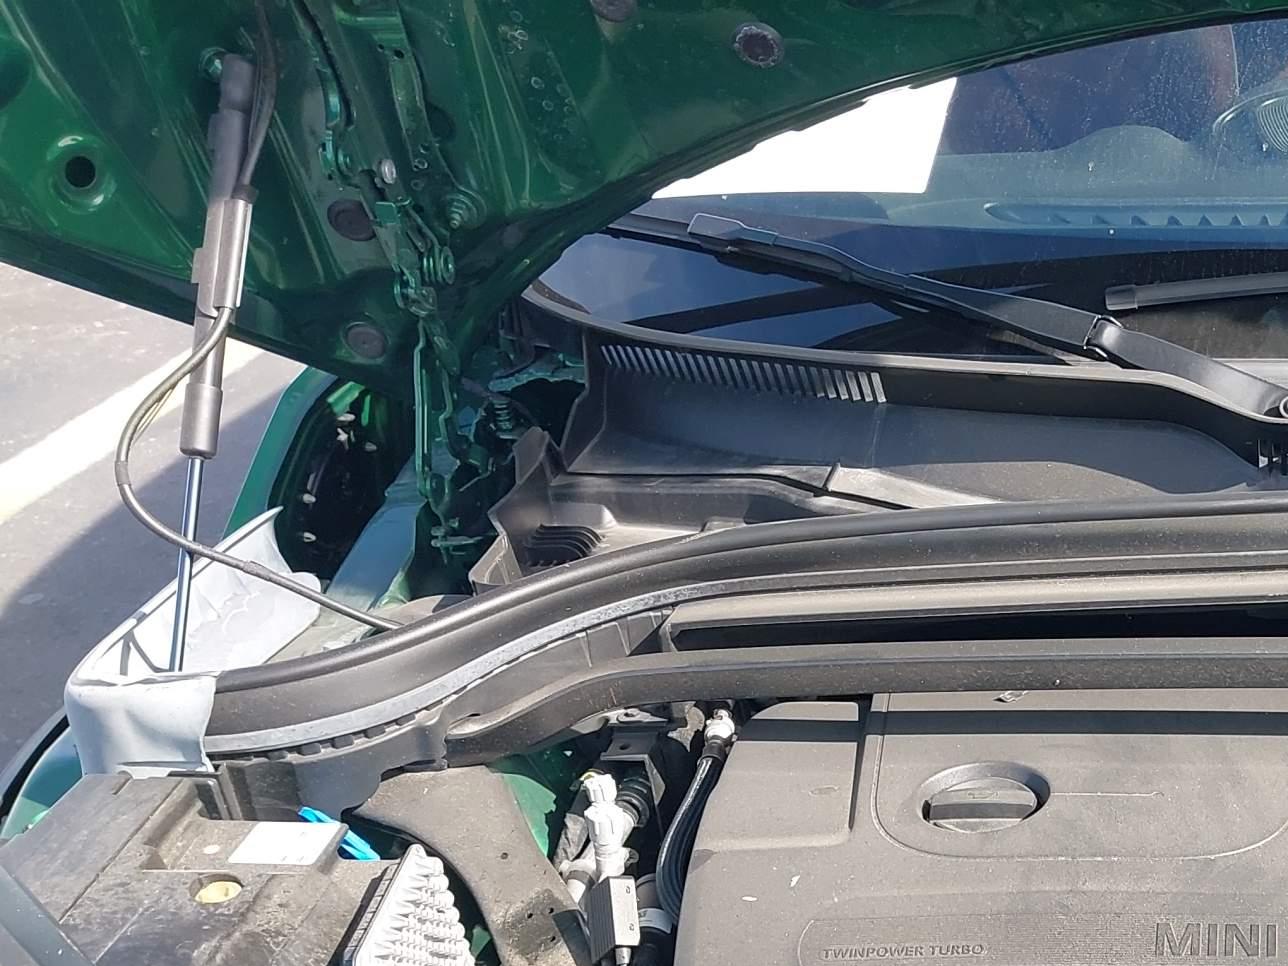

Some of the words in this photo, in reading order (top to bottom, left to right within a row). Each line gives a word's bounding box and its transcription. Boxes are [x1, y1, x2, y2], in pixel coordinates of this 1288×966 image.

[823, 945, 924, 959] TWINPOWER
[928, 943, 985, 957] TURBO
[1155, 922, 1278, 957] MINI
